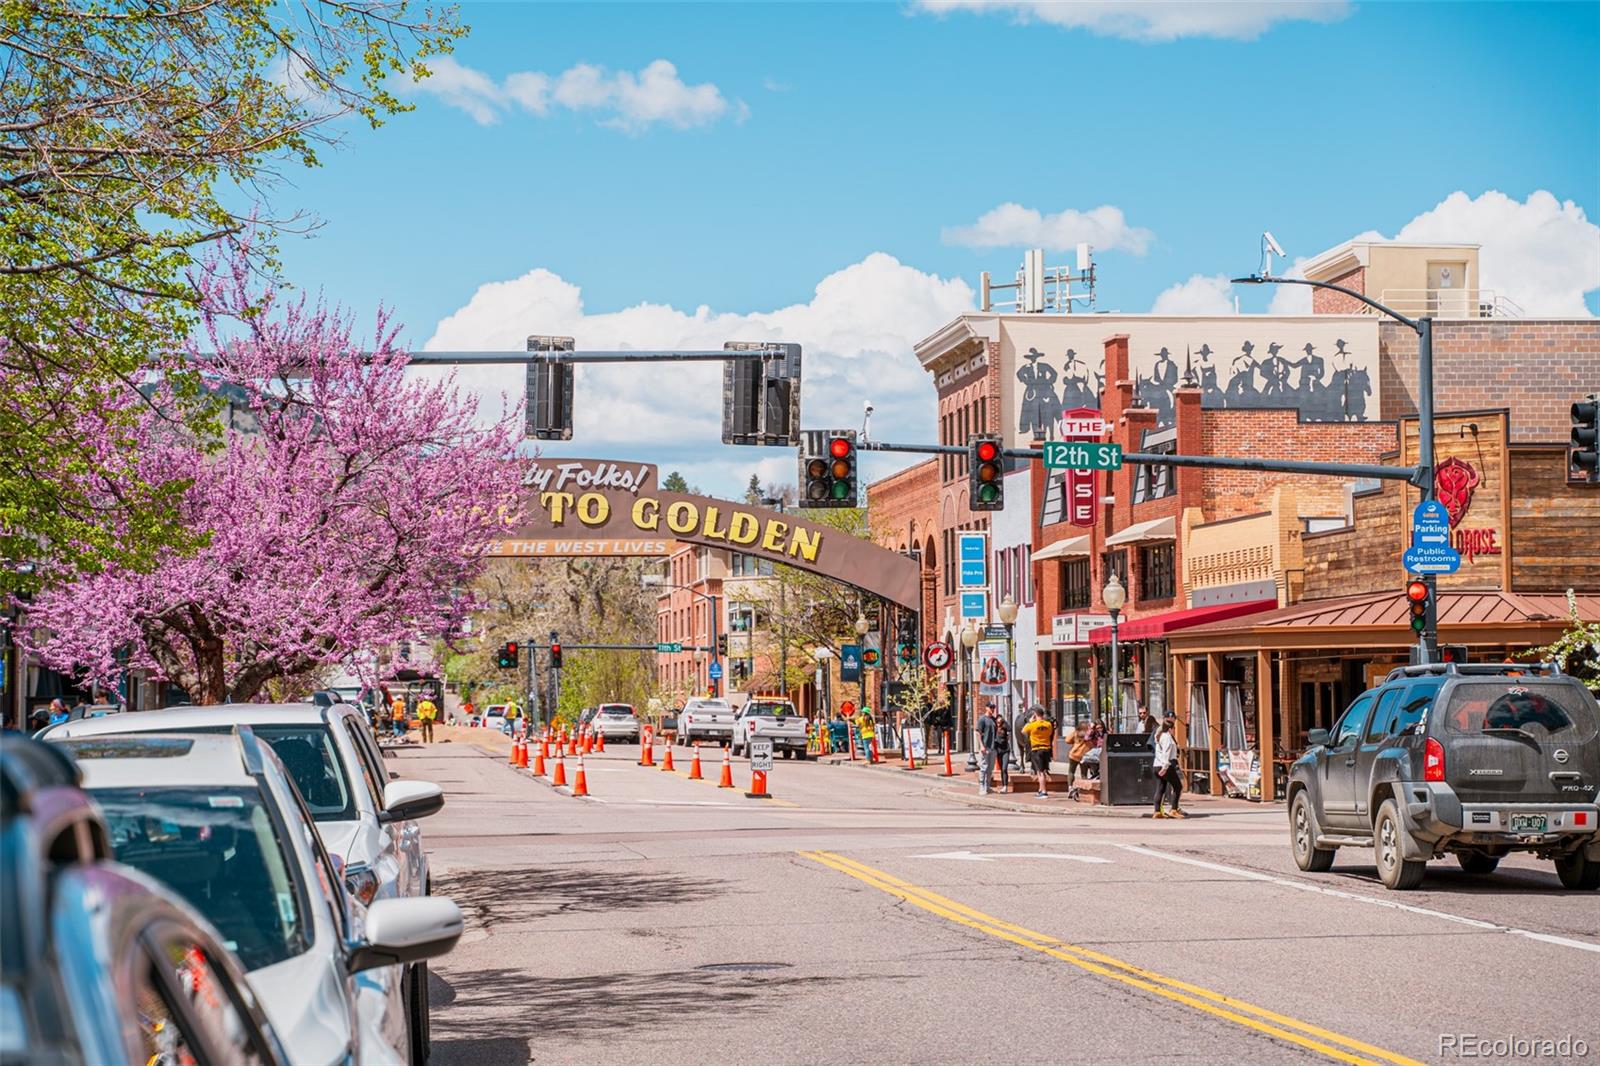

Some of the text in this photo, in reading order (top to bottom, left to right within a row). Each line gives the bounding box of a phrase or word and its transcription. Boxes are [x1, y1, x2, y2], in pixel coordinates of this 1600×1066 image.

[1066, 422, 1102, 432] THE
[1046, 445, 1118, 466] 12th St
[556, 463, 648, 493] Folks!
[541, 492, 609, 525] TO
[631, 497, 821, 561] GOLDEN
[1415, 525, 1448, 535] Parking
[511, 542, 547, 553] THE
[554, 542, 609, 553] WEST
[613, 542, 666, 553] LIVES
